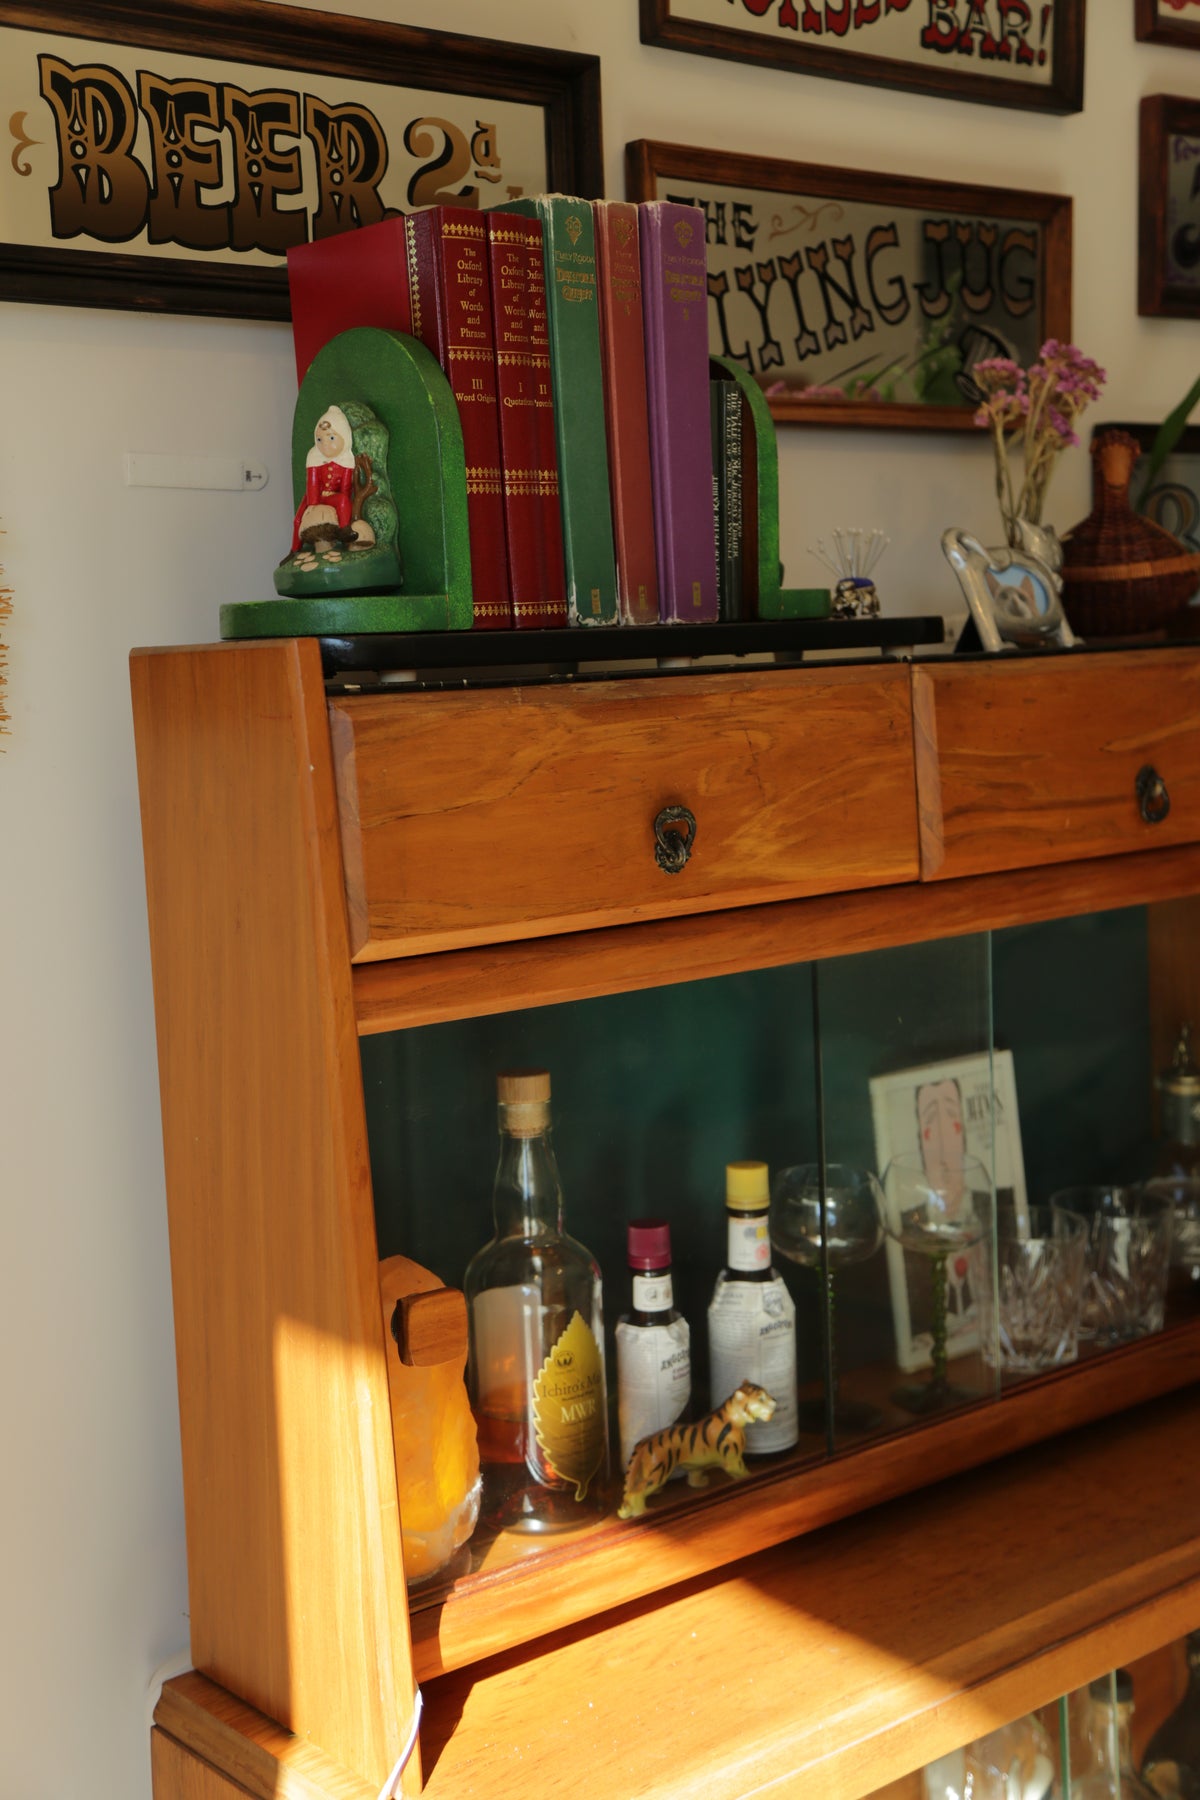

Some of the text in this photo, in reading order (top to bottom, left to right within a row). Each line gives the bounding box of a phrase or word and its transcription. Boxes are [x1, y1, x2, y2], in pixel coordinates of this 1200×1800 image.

[921, 0, 1053, 66] BAR!
[37, 53, 405, 256] BEER
[667, 194, 759, 251] HE
[464, 247, 476, 257] The
[506, 253, 519, 263] The
[457, 259, 482, 271] Oxford
[529, 258, 541, 267] The
[501, 265, 524, 277] Oxford
[457, 273, 483, 287] Library
[501, 279, 525, 292] Library
[468, 288, 476, 297] of
[512, 294, 520, 303] of
[706, 222, 911, 375] LYING
[913, 218, 1037, 319] JUG
[460, 300, 484, 312] Words
[534, 298, 542, 306] of
[504, 305, 526, 317] Words
[467, 315, 481, 325] and
[511, 321, 523, 329] and
[460, 327, 487, 339] Phrases
[533, 324, 545, 332] and
[472, 378, 483, 390] III
[455, 392, 476, 402] Word
[543, 1379, 585, 1398] Ichiro's
